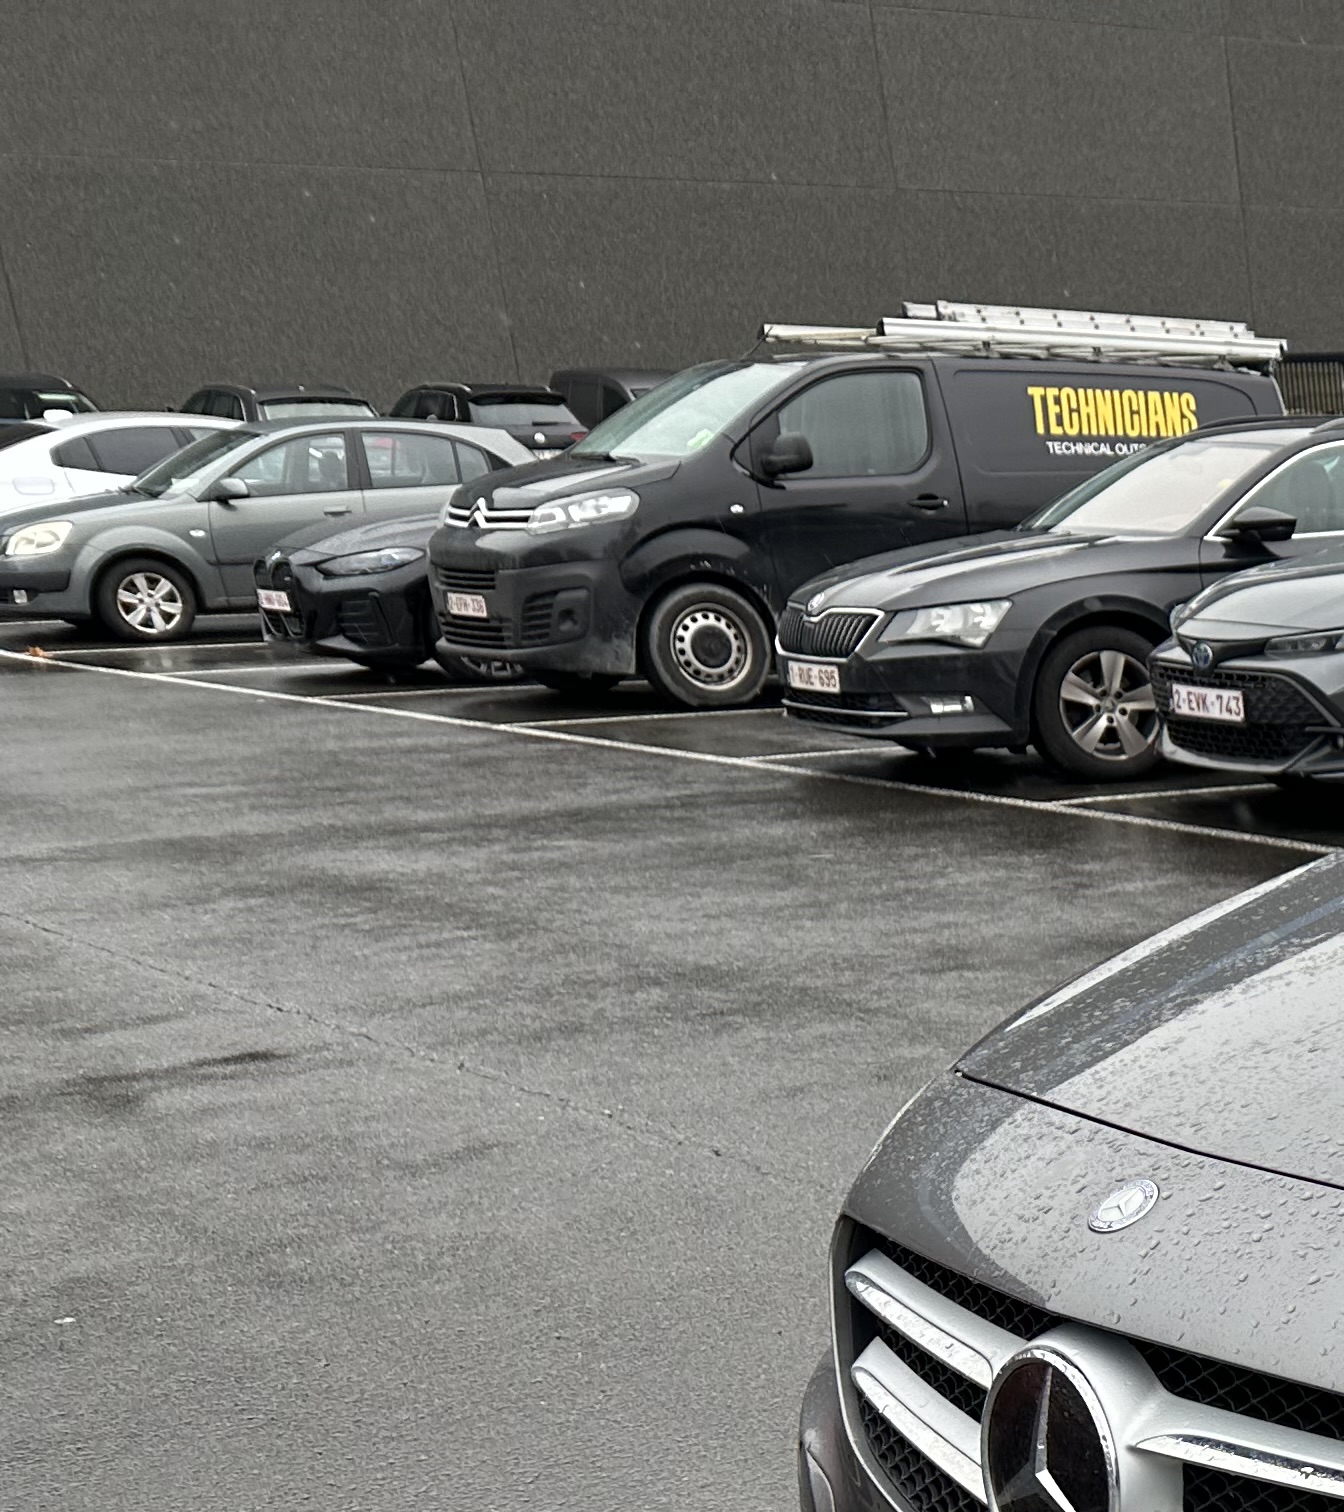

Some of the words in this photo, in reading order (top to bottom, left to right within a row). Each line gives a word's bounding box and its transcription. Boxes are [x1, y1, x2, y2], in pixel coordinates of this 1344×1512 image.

[1027, 386, 1198, 438] TECHNICIANS
[1046, 441, 1114, 456] TECHNICAL
[1175, 689, 1242, 717] 2-EVK-743
